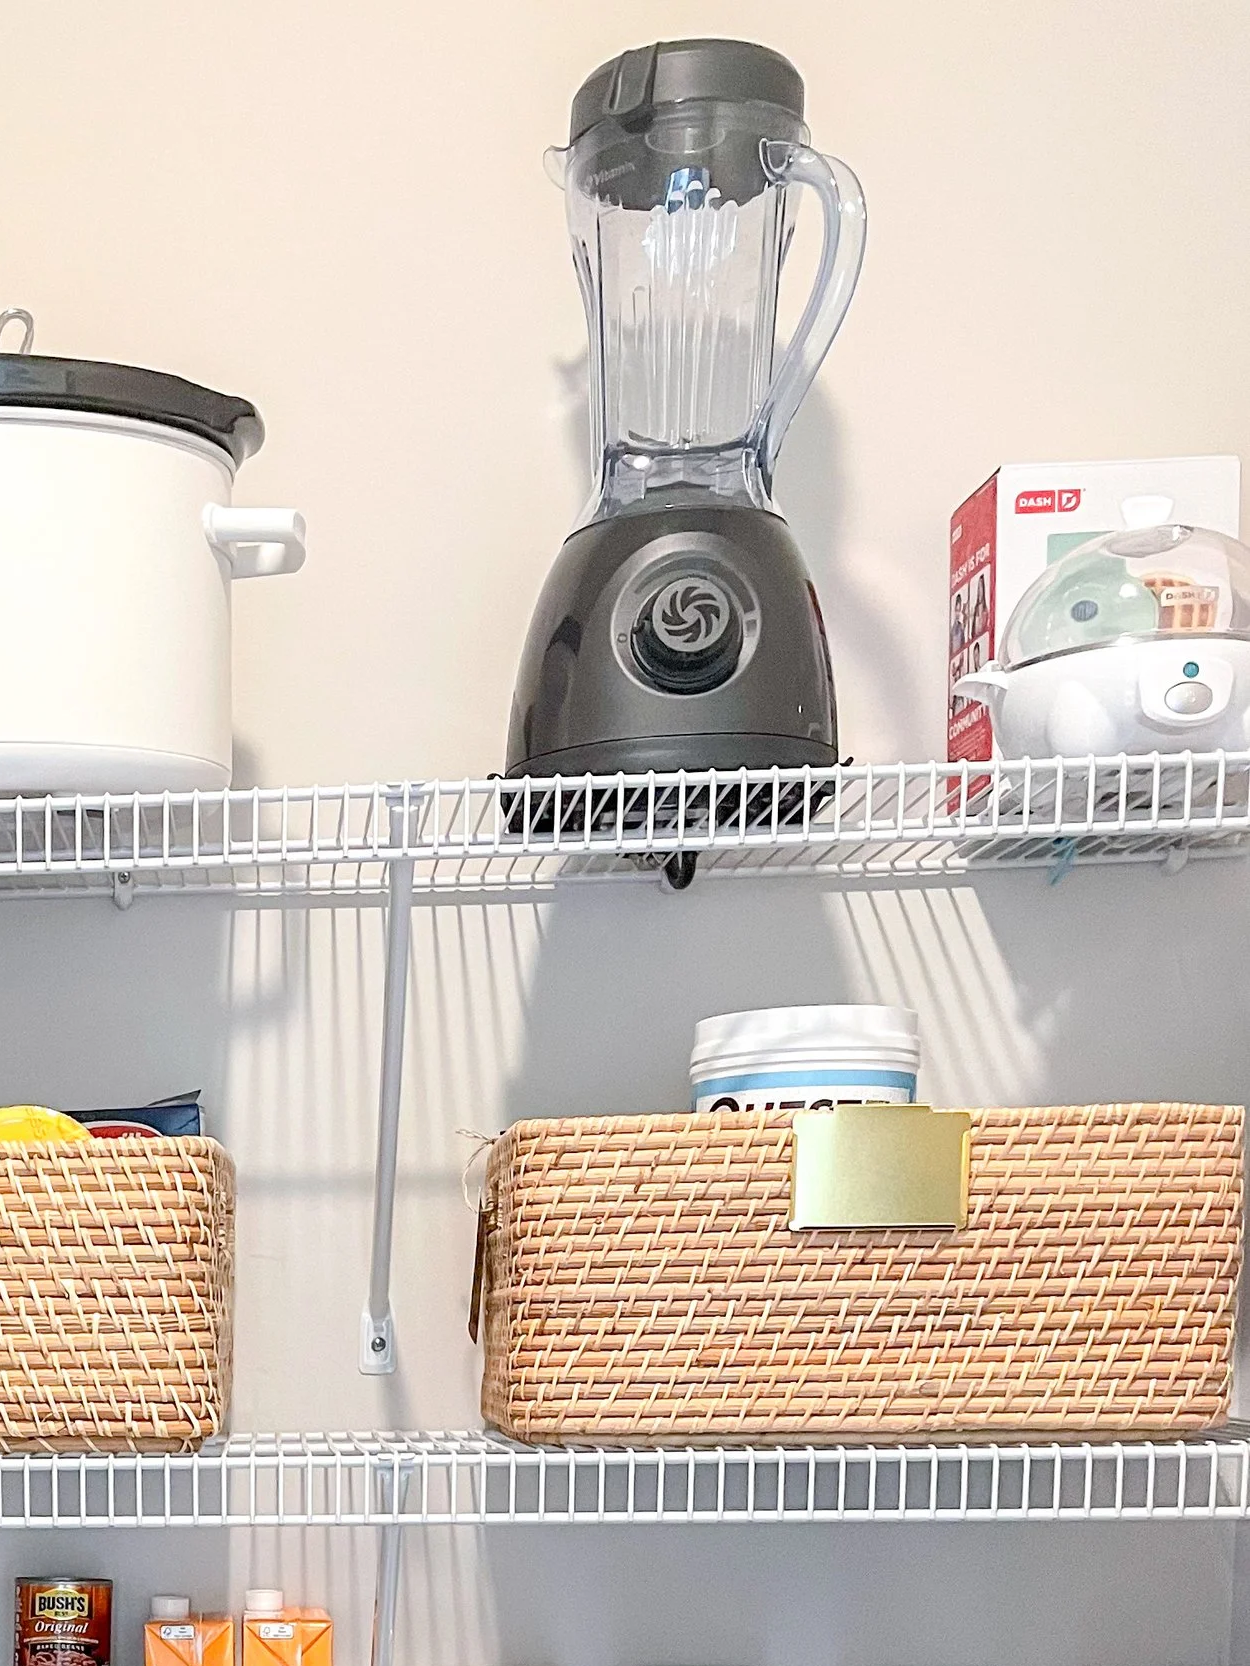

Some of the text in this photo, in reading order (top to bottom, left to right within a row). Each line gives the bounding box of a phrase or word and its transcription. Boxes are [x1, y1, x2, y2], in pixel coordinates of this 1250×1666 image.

[1019, 497, 1052, 508] DASH
[38, 1595, 86, 1613] BUSH'S
[34, 1620, 90, 1635] Original
